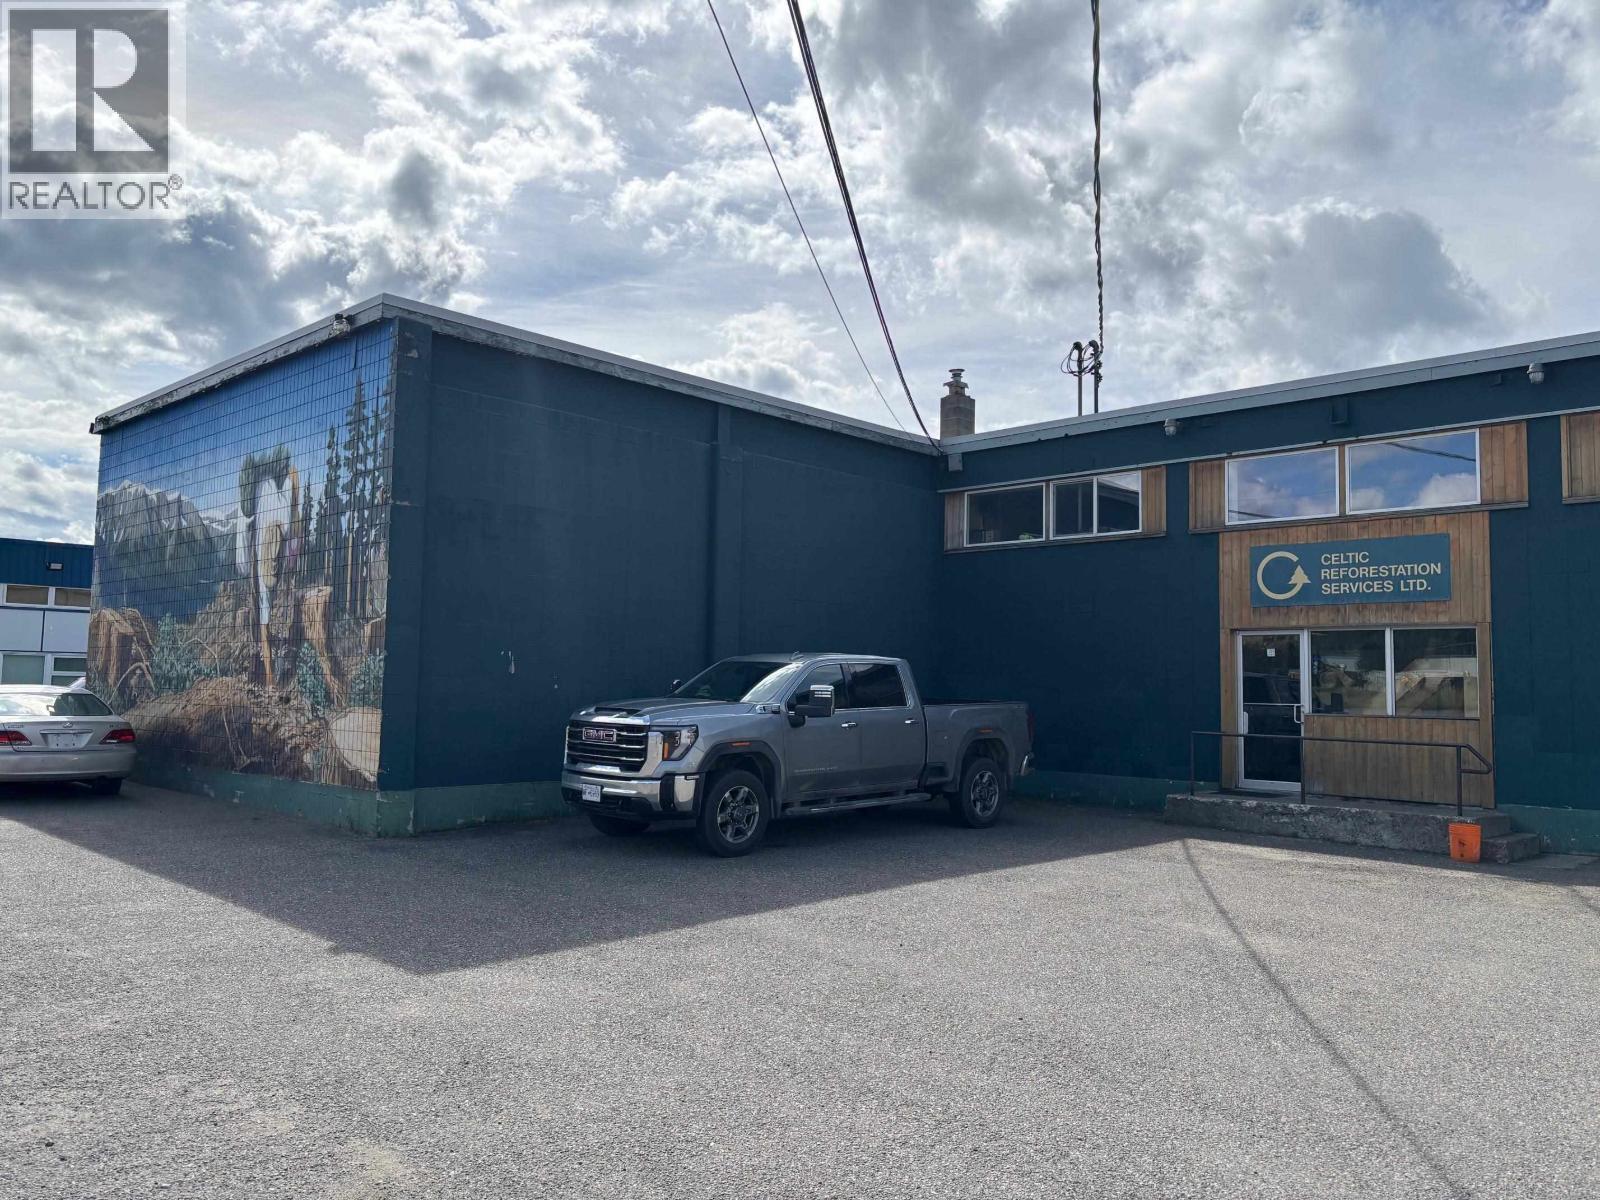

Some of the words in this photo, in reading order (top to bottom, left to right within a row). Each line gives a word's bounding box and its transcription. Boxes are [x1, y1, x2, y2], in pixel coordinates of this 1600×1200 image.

[1320, 551, 1369, 566] CELTIC
[1320, 562, 1442, 581] REFORESTATION
[1320, 581, 1394, 595] SERVICES
[1400, 579, 1432, 592] LTD.
[584, 729, 614, 741] GMC
